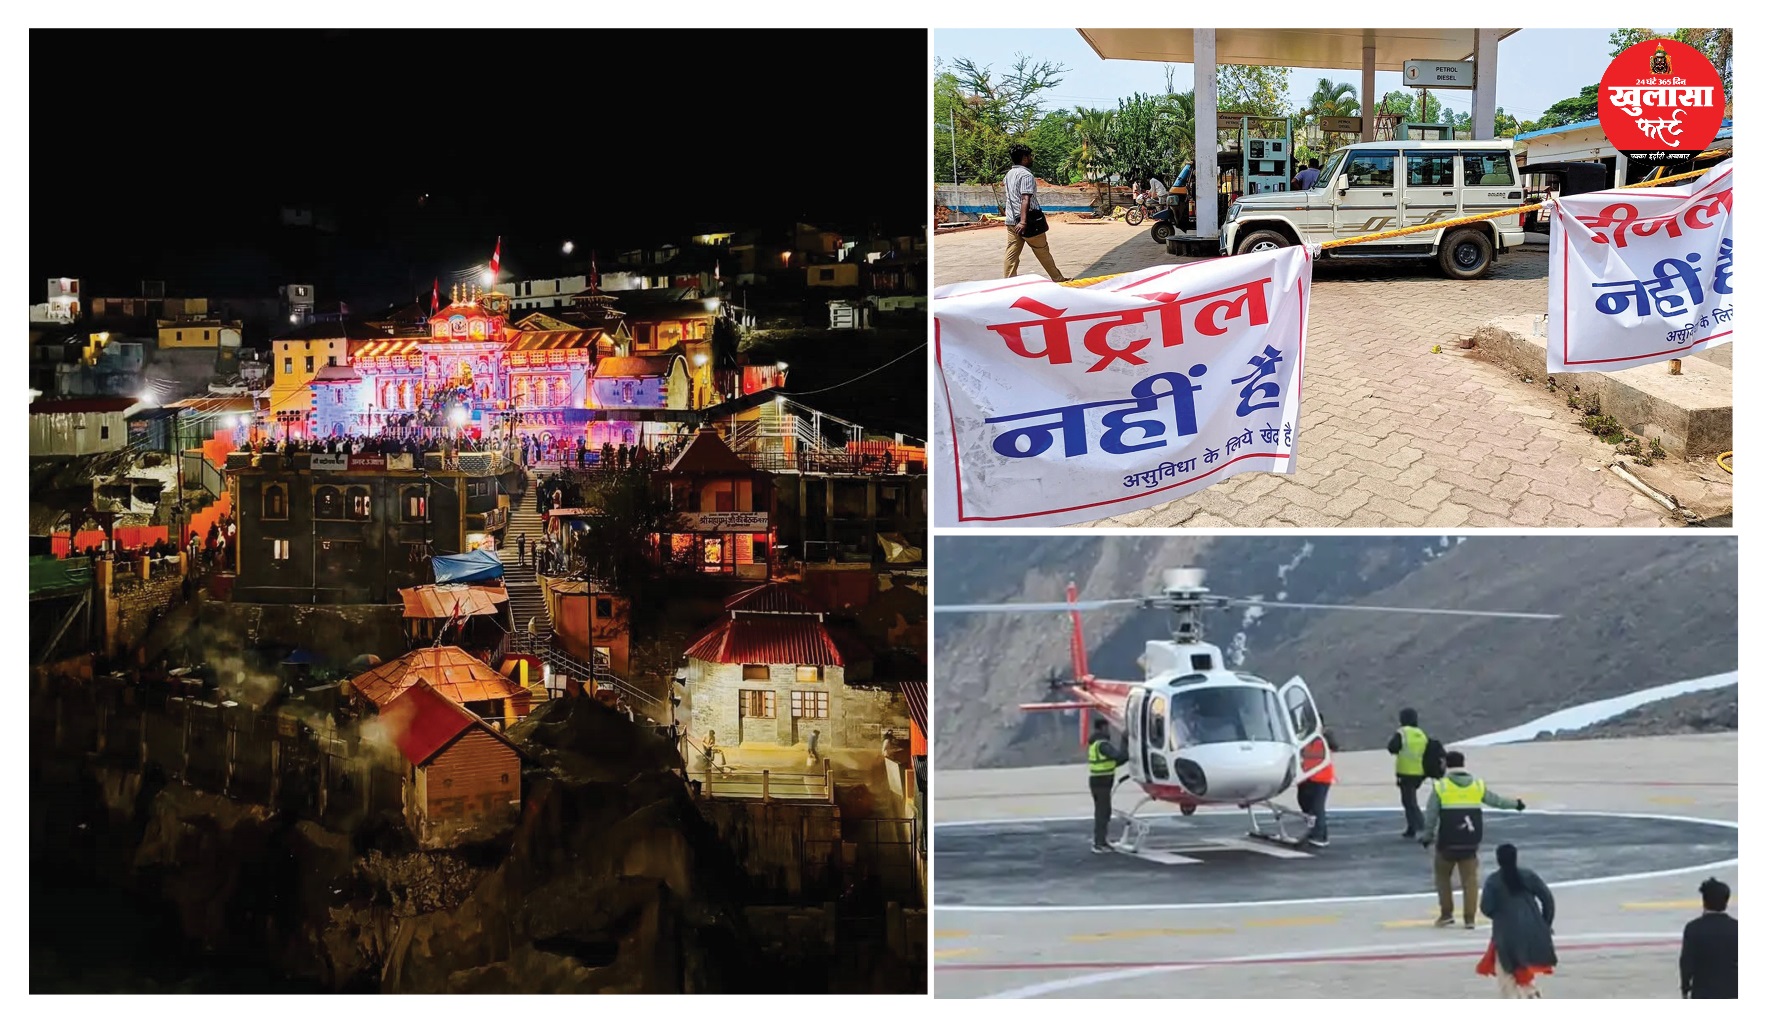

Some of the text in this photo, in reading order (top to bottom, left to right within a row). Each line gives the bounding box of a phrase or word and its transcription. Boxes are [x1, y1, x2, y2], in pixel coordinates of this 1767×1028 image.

[1411, 68, 1416, 77] 1
[1592, 252, 1704, 318] नहीं
[985, 344, 1283, 459] नहीं है
[1122, 422, 1293, 488] असुविधा के लिये खेद है
